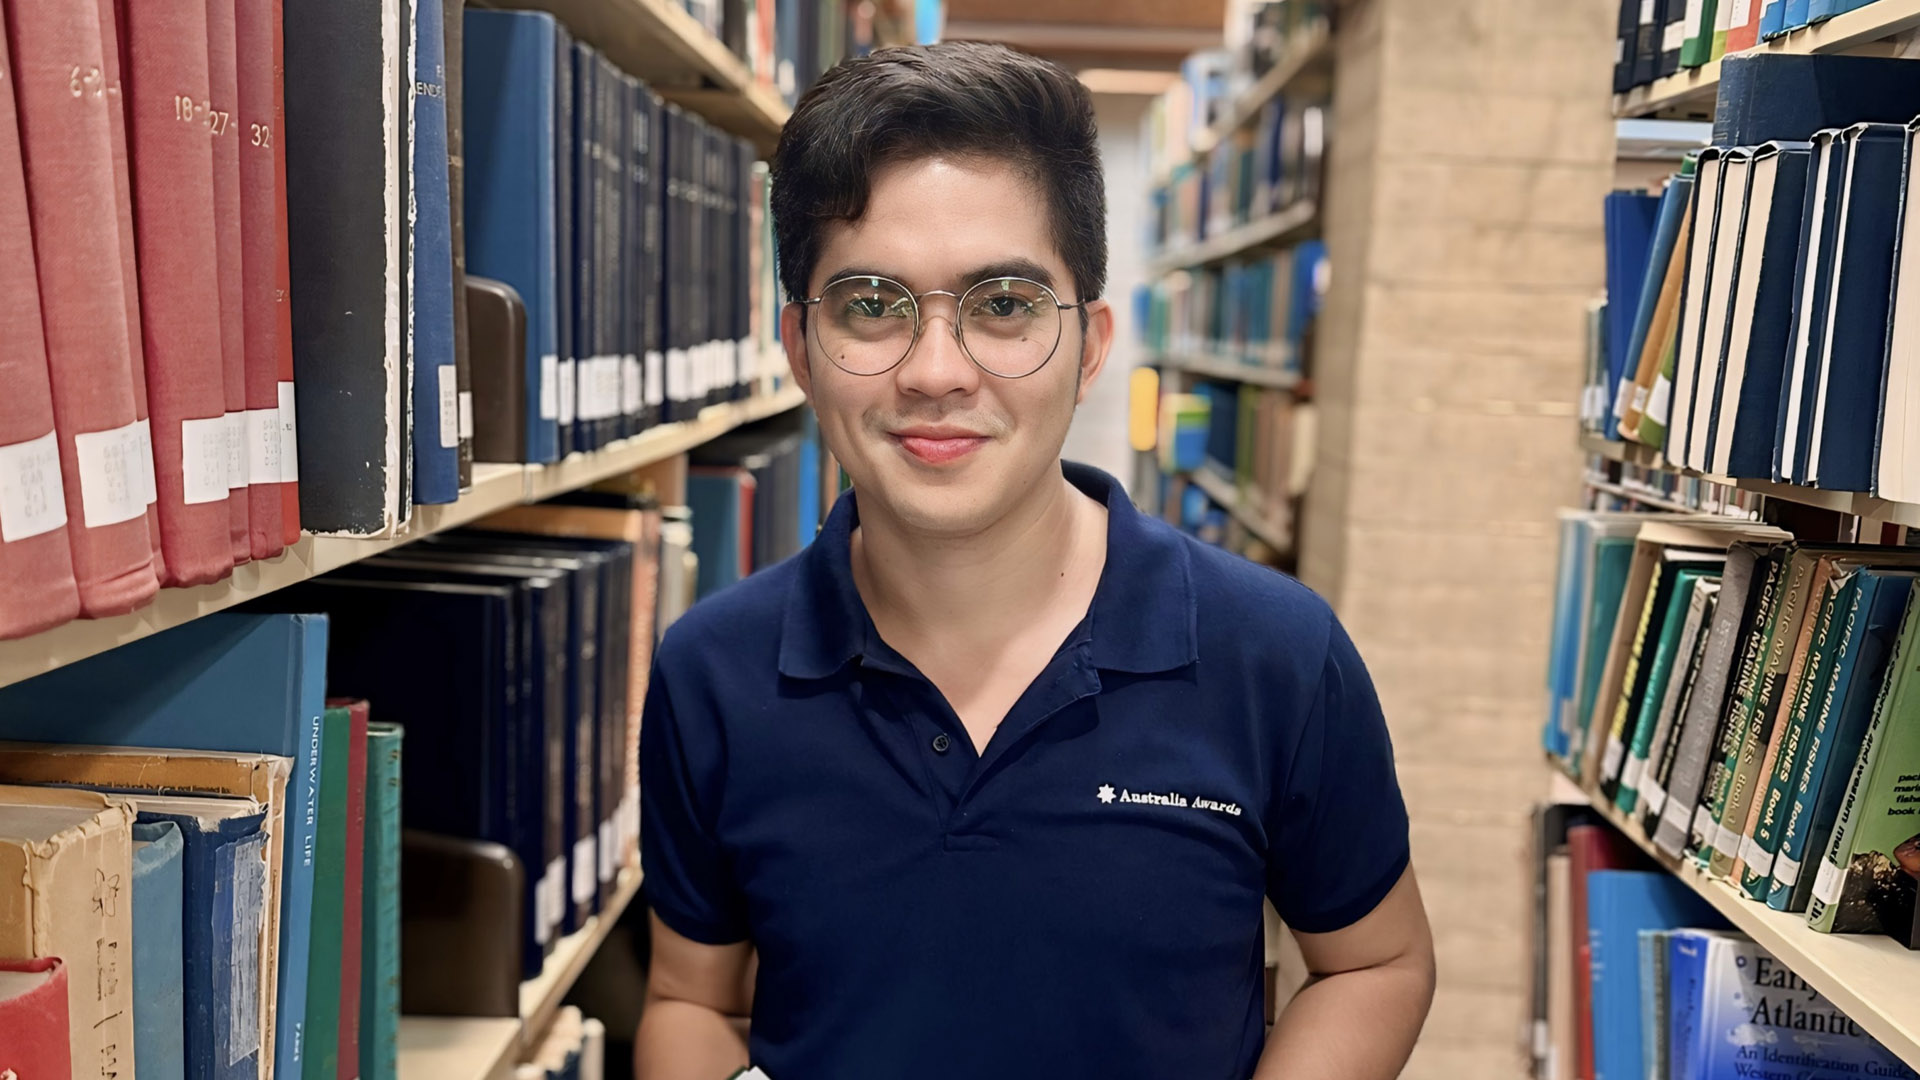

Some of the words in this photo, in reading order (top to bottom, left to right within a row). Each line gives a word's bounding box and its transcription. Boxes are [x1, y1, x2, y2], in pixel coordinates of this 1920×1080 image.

[1755, 560, 1780, 627] PACIFIC
[1781, 565, 1805, 634] PACIFIC
[1839, 586, 1863, 658] PACIFIC
[1737, 631, 1762, 698] MARINE
[1760, 638, 1785, 707] MARINE
[1797, 650, 1822, 722] MARINE
[1816, 662, 1841, 734] MARINE
[1721, 700, 1745, 754] FISHES
[1744, 709, 1765, 765] FISHES
[1780, 724, 1802, 782] FISHES
[305, 716, 320, 826] UNDERWATER
[1731, 773, 1747, 812] Book
[1800, 736, 1821, 794] FISHES
[1119, 789, 1188, 808] Australia
[1191, 795, 1242, 817] Awards
[1763, 788, 1781, 826] Book
[1786, 800, 1803, 838] Book
[1888, 807, 1916, 816] book
[304, 834, 313, 867] LIFE
[1760, 828, 1770, 840] 5
[1782, 840, 1791, 853] 6
[1736, 1045, 1758, 1060] An
[1763, 1046, 1860, 1073] Identification
